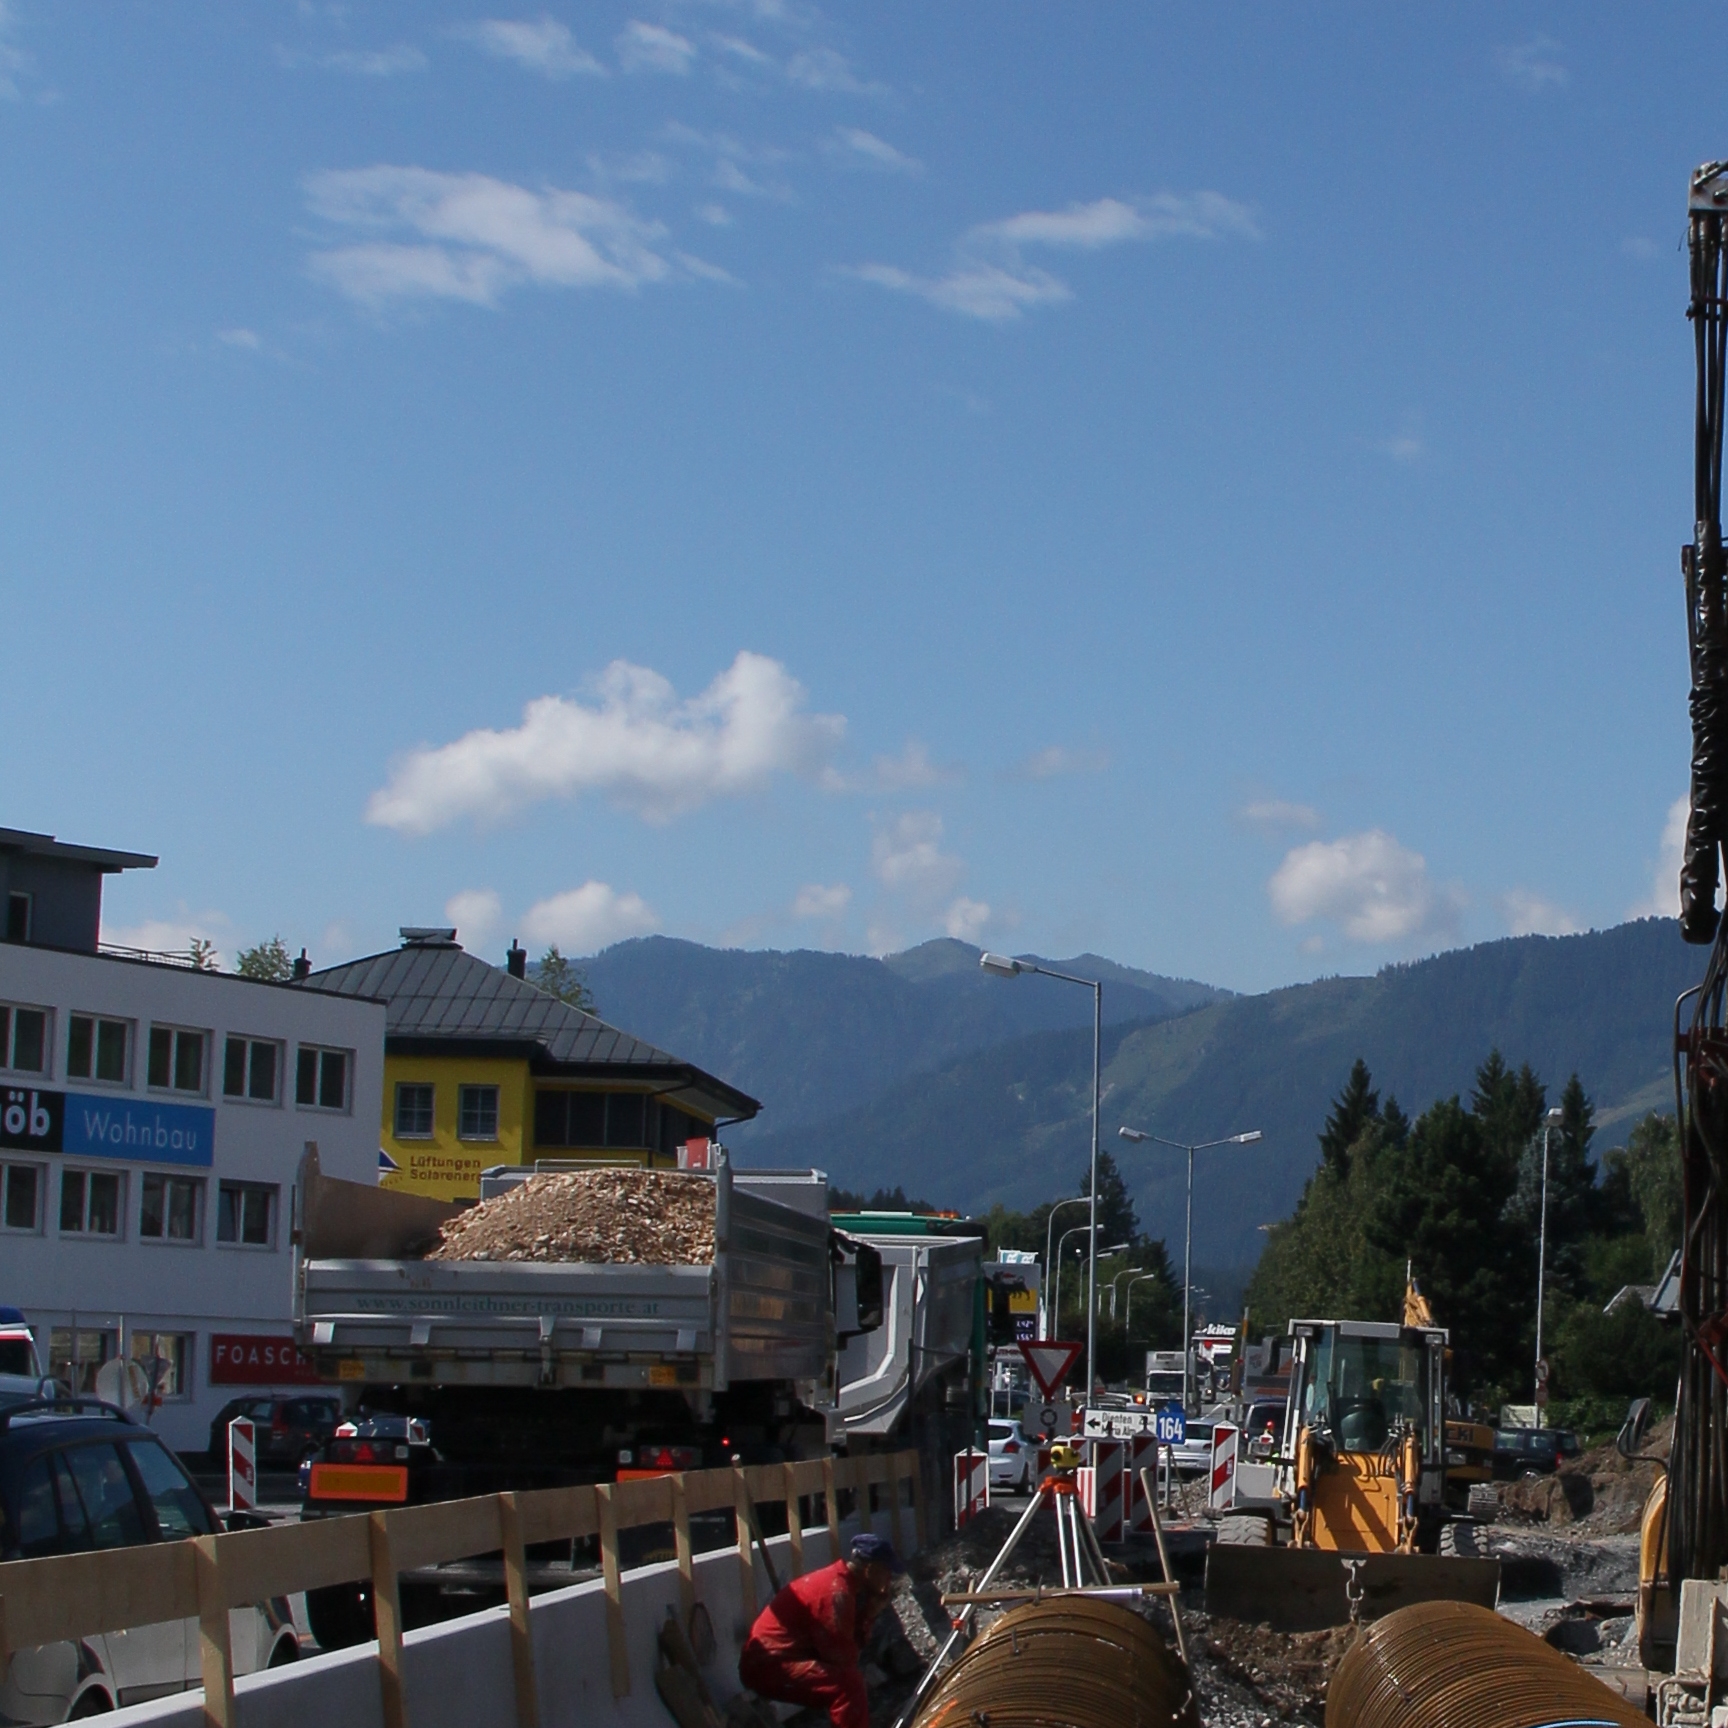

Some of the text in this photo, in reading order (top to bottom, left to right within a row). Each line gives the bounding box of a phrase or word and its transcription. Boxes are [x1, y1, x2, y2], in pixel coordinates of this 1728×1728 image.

[0, 1091, 50, 1136] öb
[84, 1110, 196, 1150] Wohnbau
[410, 1156, 481, 1170] Lüftungen
[1159, 1416, 1183, 1440] 164
